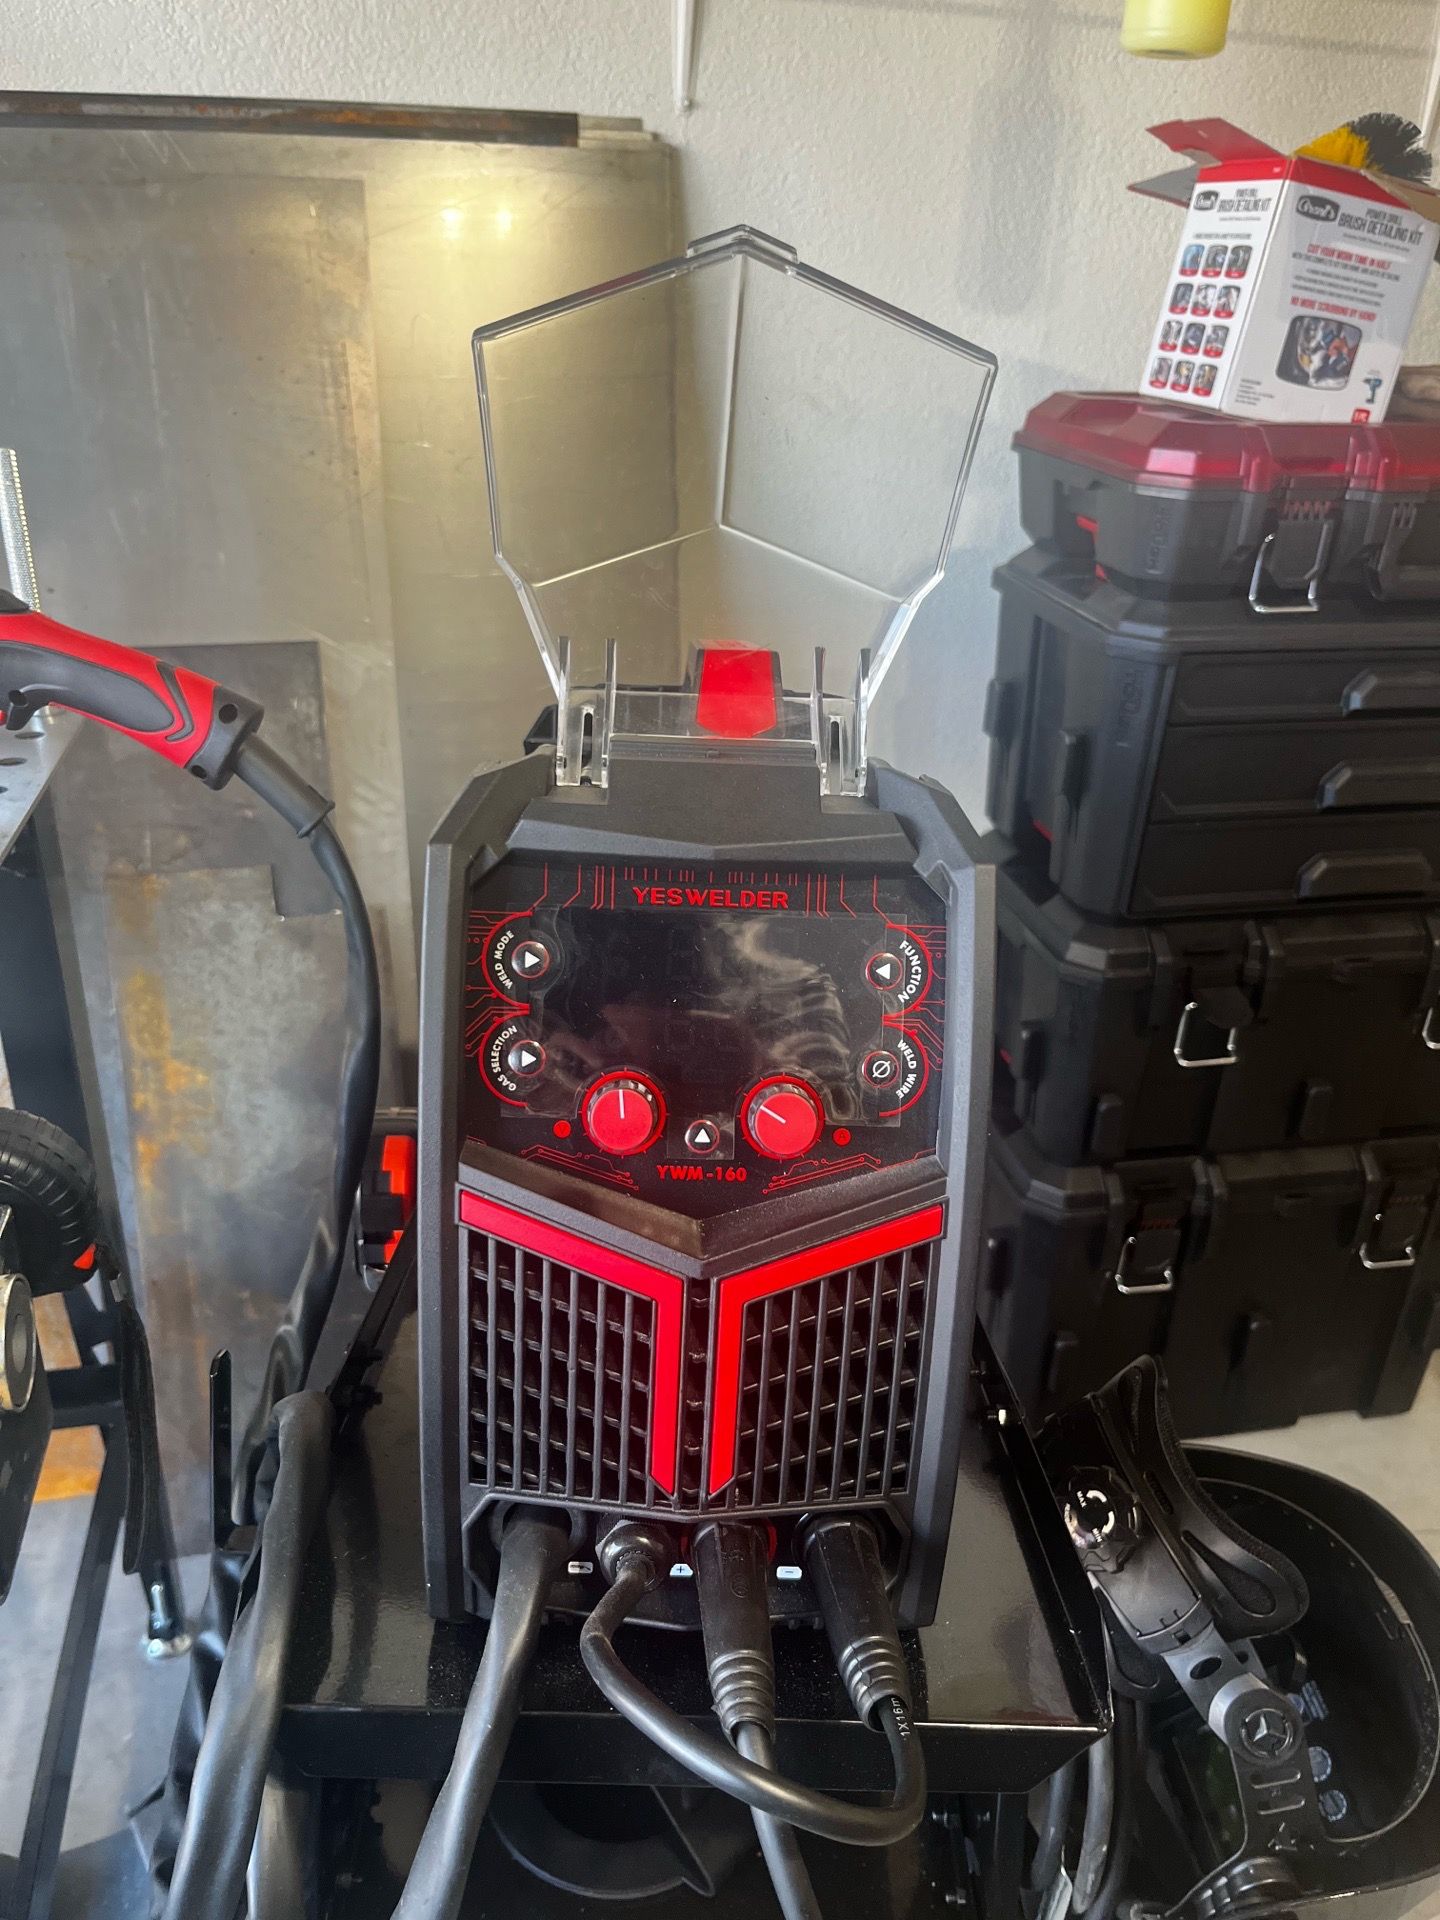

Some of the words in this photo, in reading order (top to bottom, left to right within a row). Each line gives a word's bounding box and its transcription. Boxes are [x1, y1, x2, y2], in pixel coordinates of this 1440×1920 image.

[1338, 212, 1366, 231] BRUSH
[1366, 220, 1409, 241] DETAILING
[1408, 230, 1424, 246] KIT
[632, 886, 789, 909] YESWELDER
[494, 930, 515, 959] MODE
[494, 962, 514, 989] WELD
[897, 940, 922, 1003] FUNCTION
[490, 1025, 518, 1073] SELECTION
[897, 1039, 917, 1069] WELD
[497, 1074, 517, 1091] GAS
[895, 1073, 917, 1099] WIRE
[656, 1165, 748, 1183] YWM-160
[1076, 1490, 1088, 1508] MAX
